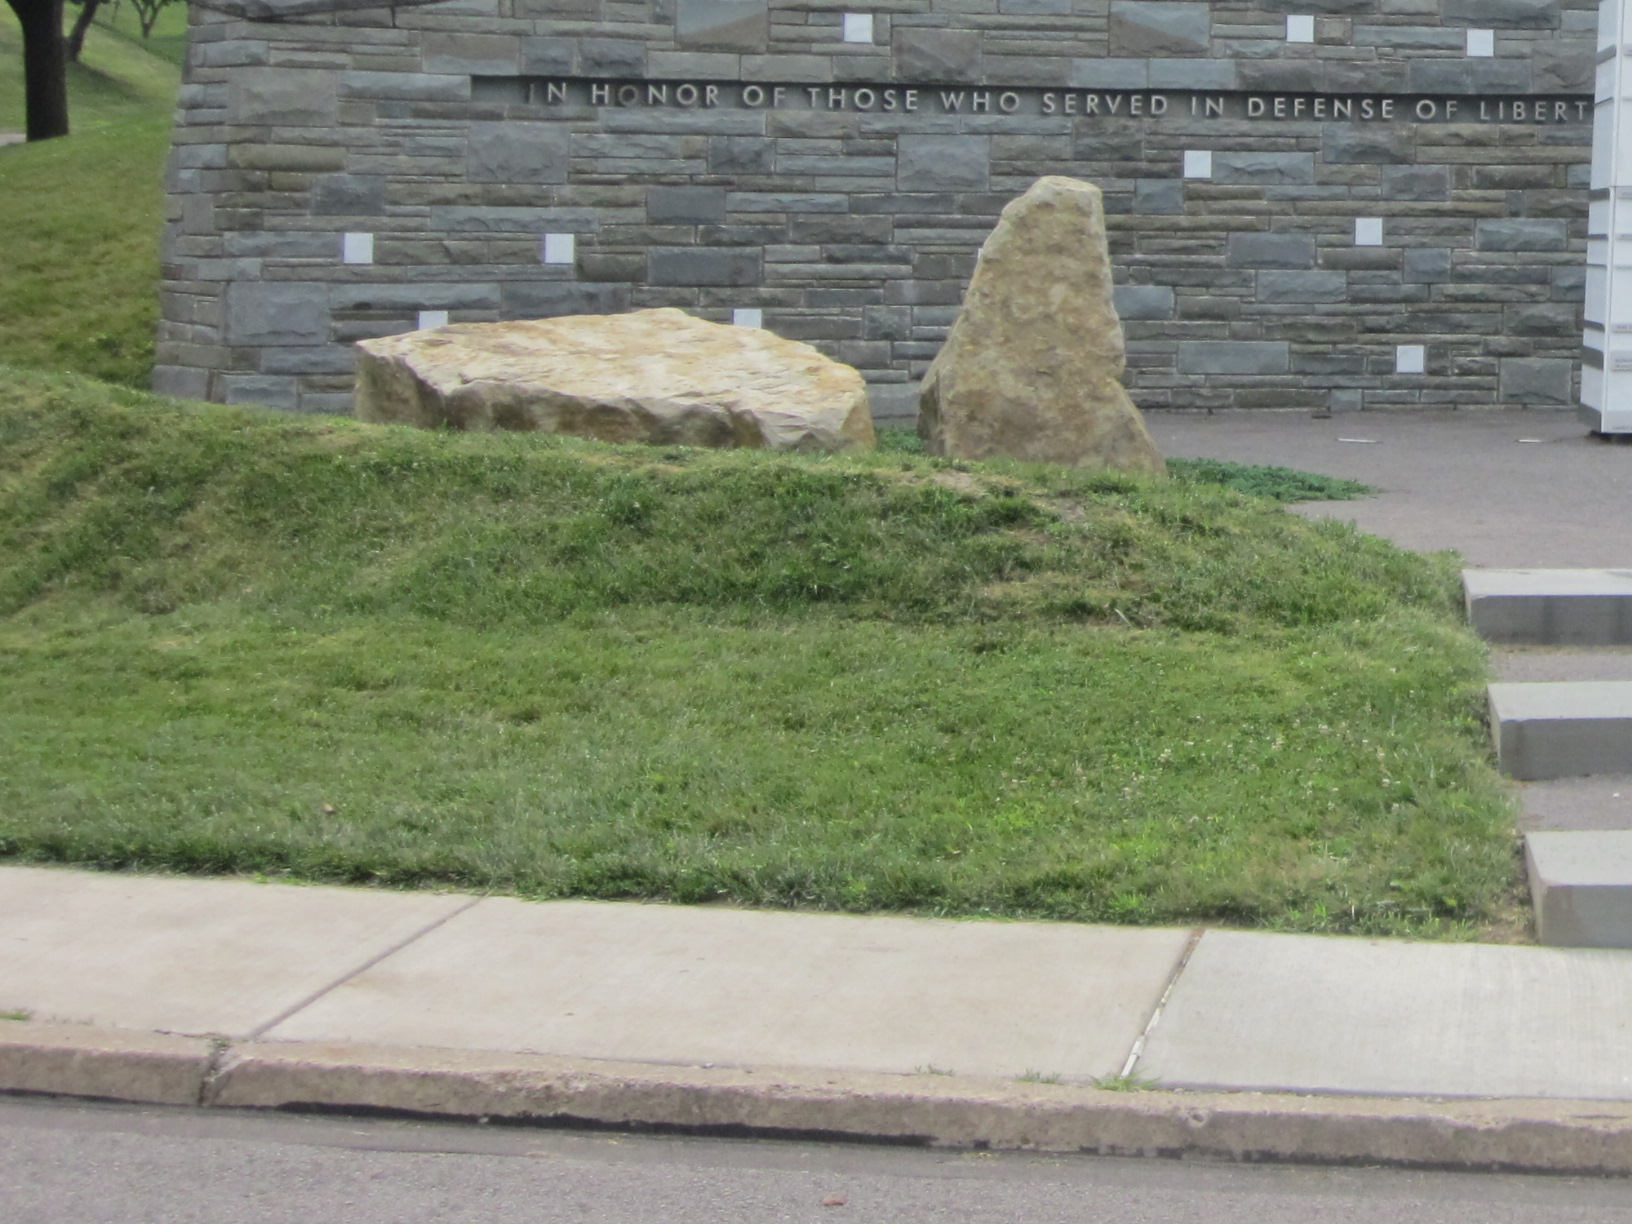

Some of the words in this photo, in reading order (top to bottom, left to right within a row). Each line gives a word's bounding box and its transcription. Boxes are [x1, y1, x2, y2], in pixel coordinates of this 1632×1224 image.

[528, 83, 567, 104] IN
[592, 85, 719, 107] HONOR
[742, 86, 786, 107] OF
[807, 87, 919, 110] THOSE
[940, 91, 1020, 112] WHO
[1042, 92, 1168, 114] SERVED
[1190, 97, 1225, 117] IN
[1247, 97, 1394, 119] DEFENSE
[1415, 99, 1459, 119] OF
[1480, 100, 1588, 121] LIBERT
